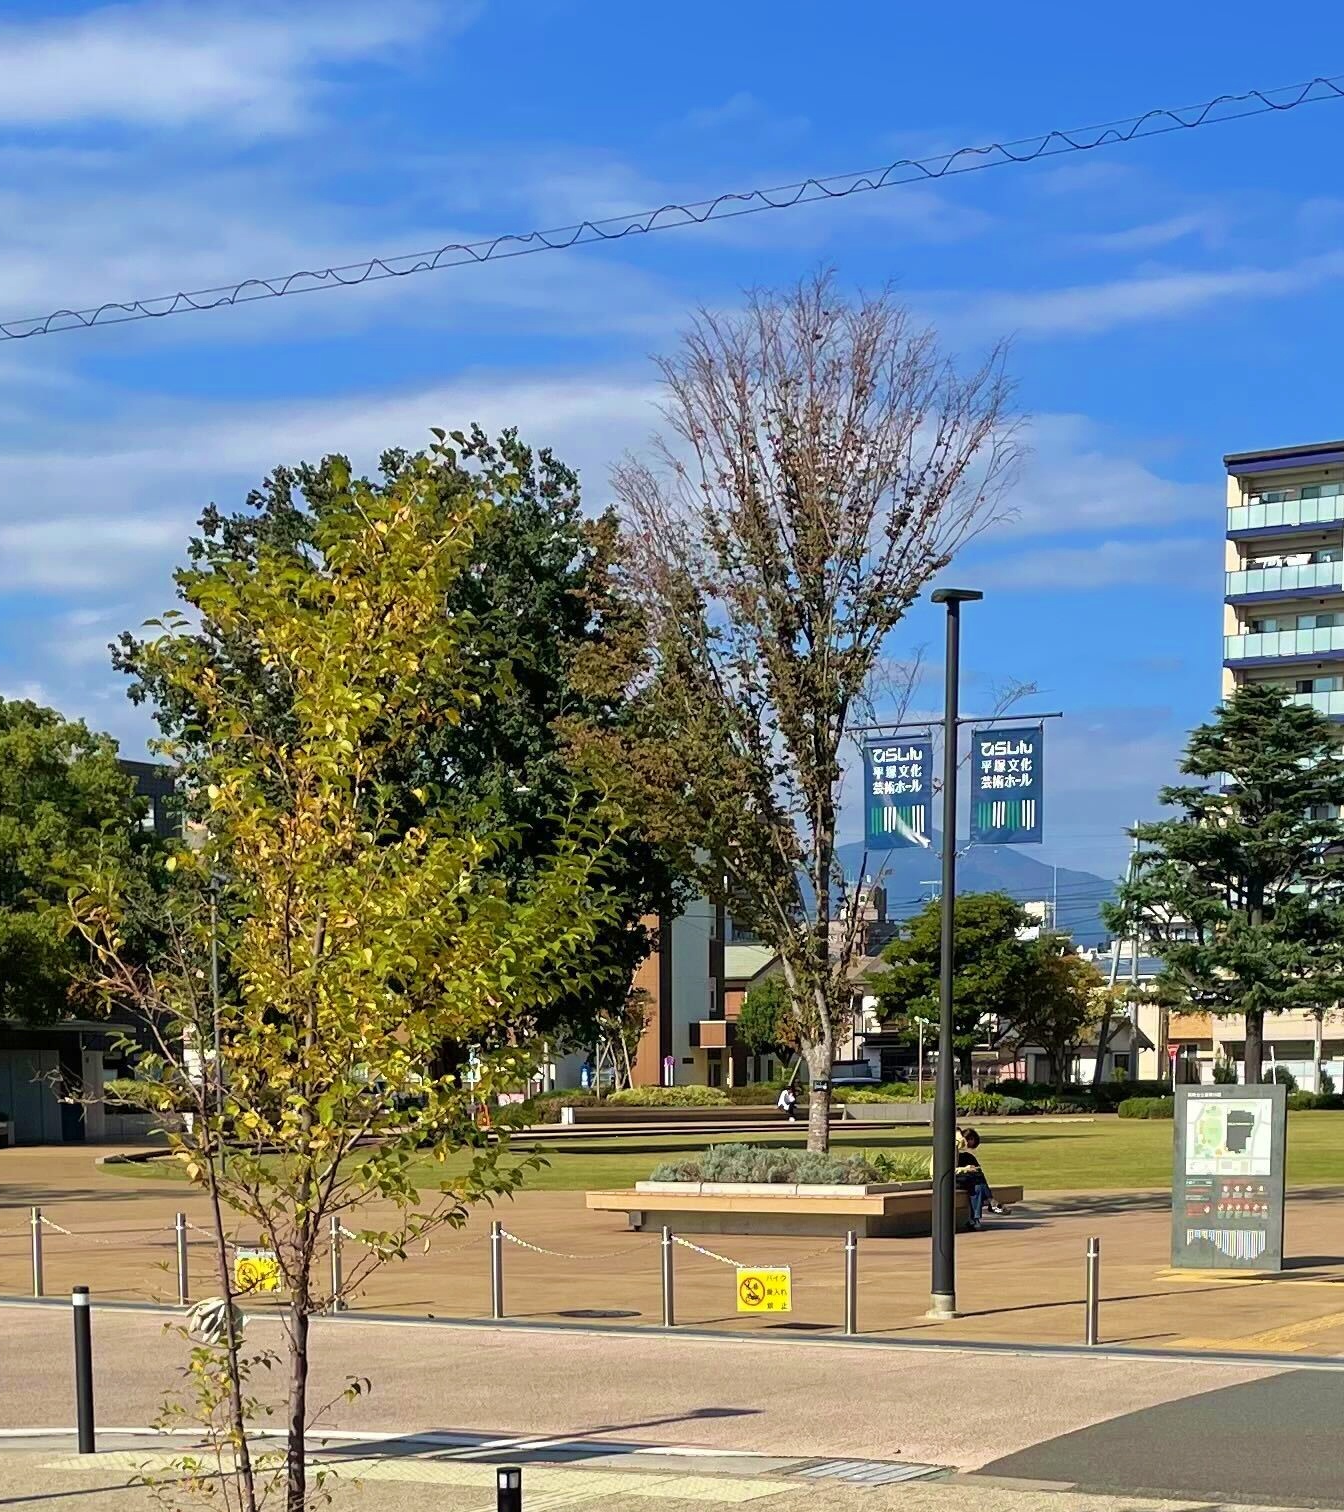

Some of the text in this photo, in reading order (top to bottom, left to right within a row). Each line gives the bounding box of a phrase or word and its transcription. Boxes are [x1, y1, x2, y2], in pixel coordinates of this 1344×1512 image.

[872, 746, 923, 763] ひらしん
[980, 740, 1033, 757] ひらしん
[873, 764, 923, 780] 平塚文化
[980, 758, 1033, 774] 平塚文化
[873, 779, 923, 795] 芸術ホール
[981, 773, 1033, 789] 芸術ホール
